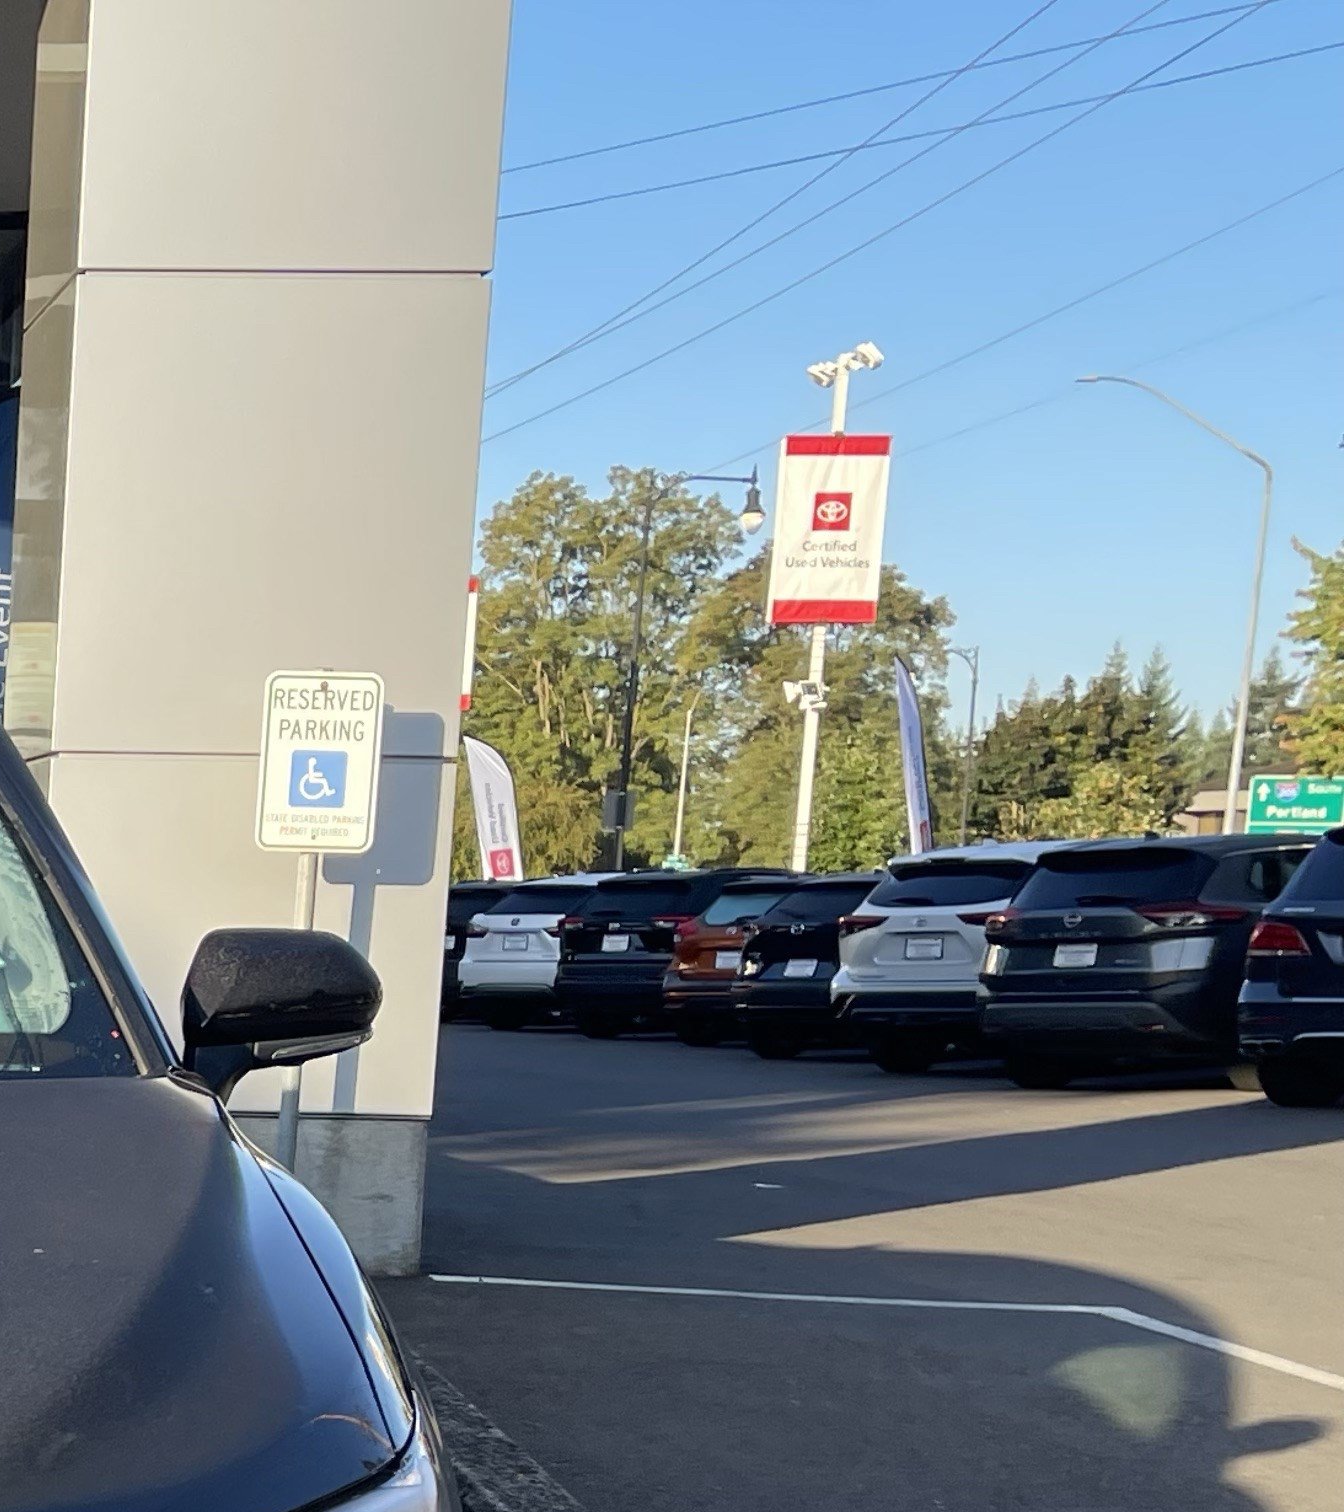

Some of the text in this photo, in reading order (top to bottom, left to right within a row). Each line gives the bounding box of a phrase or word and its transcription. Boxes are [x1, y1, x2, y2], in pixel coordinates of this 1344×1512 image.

[802, 540, 857, 552] Certified
[785, 556, 870, 568] Used Vehicles
[273, 688, 375, 712] RESERVED
[278, 718, 365, 741] PARKING
[1266, 805, 1328, 819] Portland
